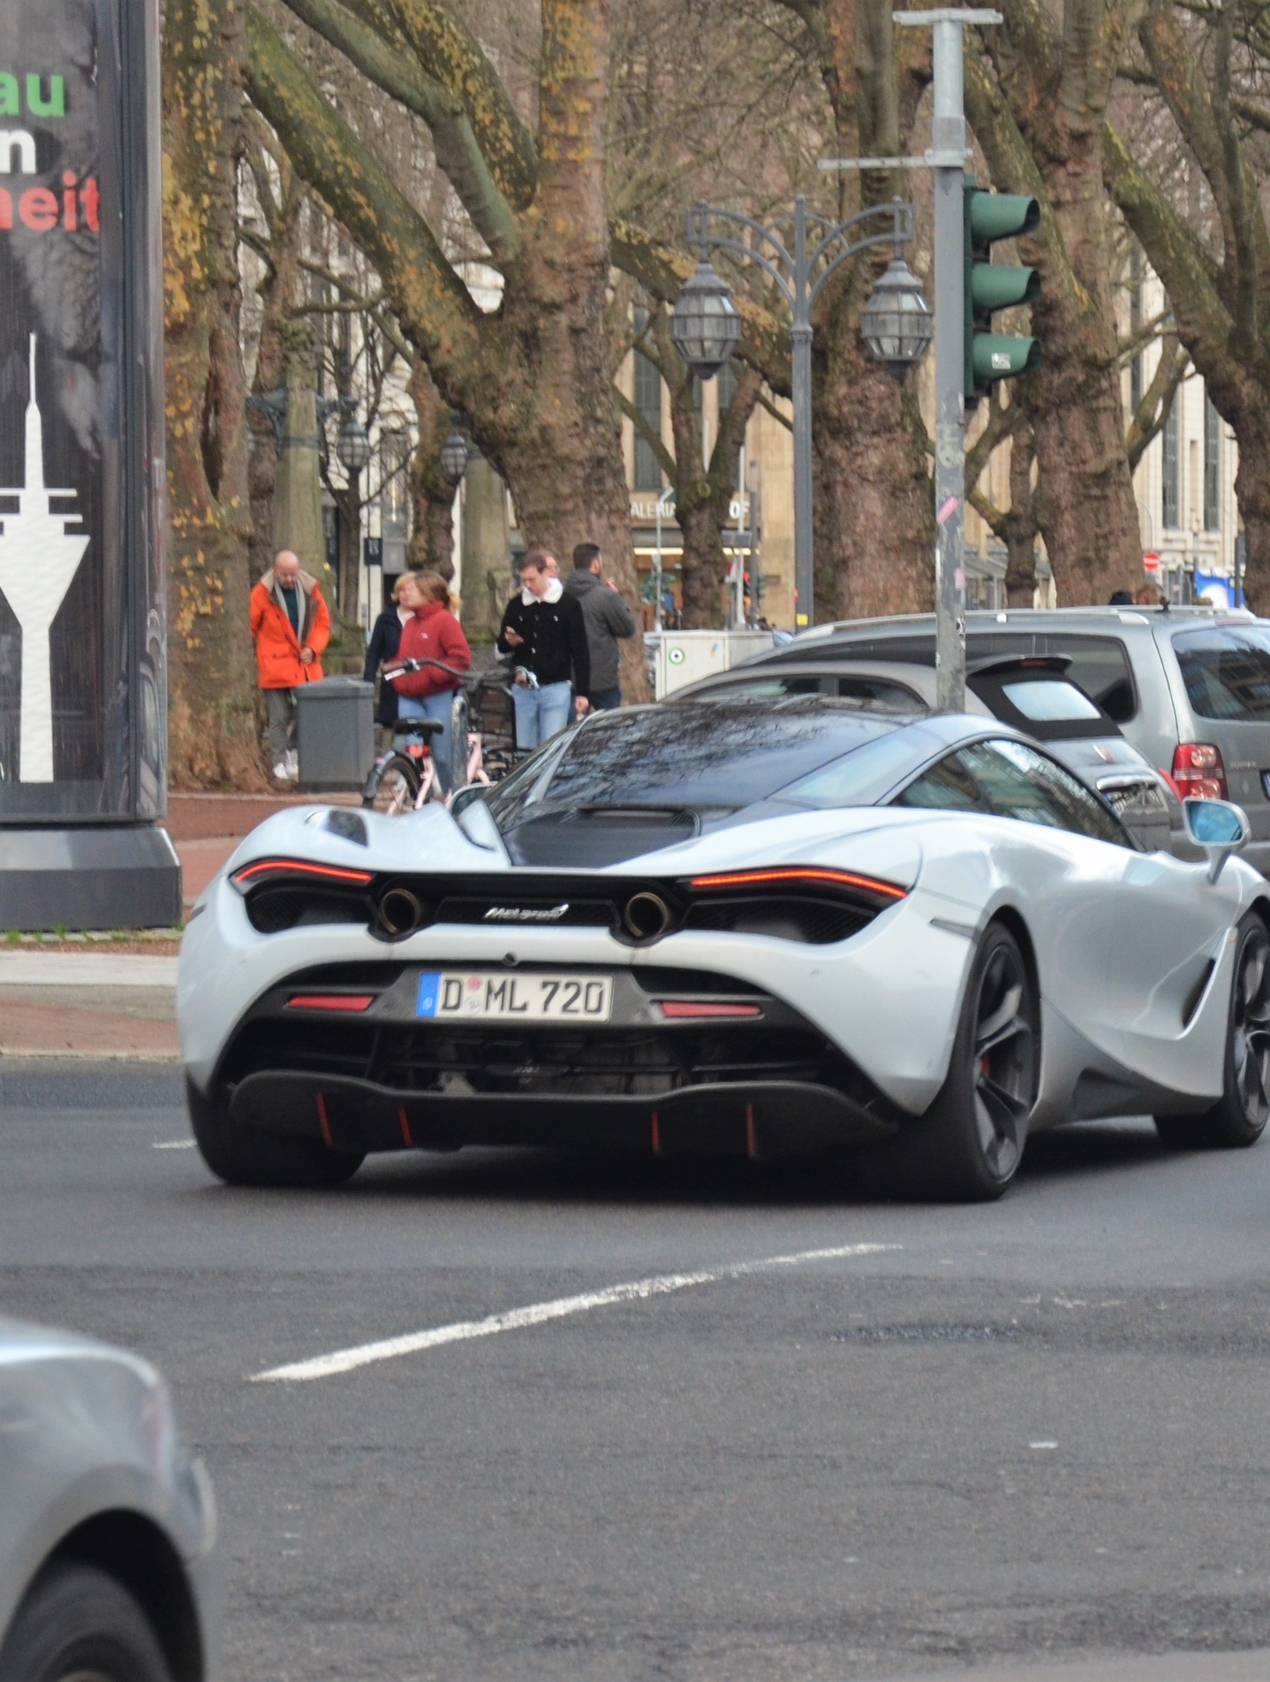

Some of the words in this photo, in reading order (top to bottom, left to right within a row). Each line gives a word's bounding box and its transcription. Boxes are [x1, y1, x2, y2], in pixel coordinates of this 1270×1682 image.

[441, 980, 462, 1011] D
[485, 979, 528, 1011] ML
[541, 981, 603, 1014] 720
